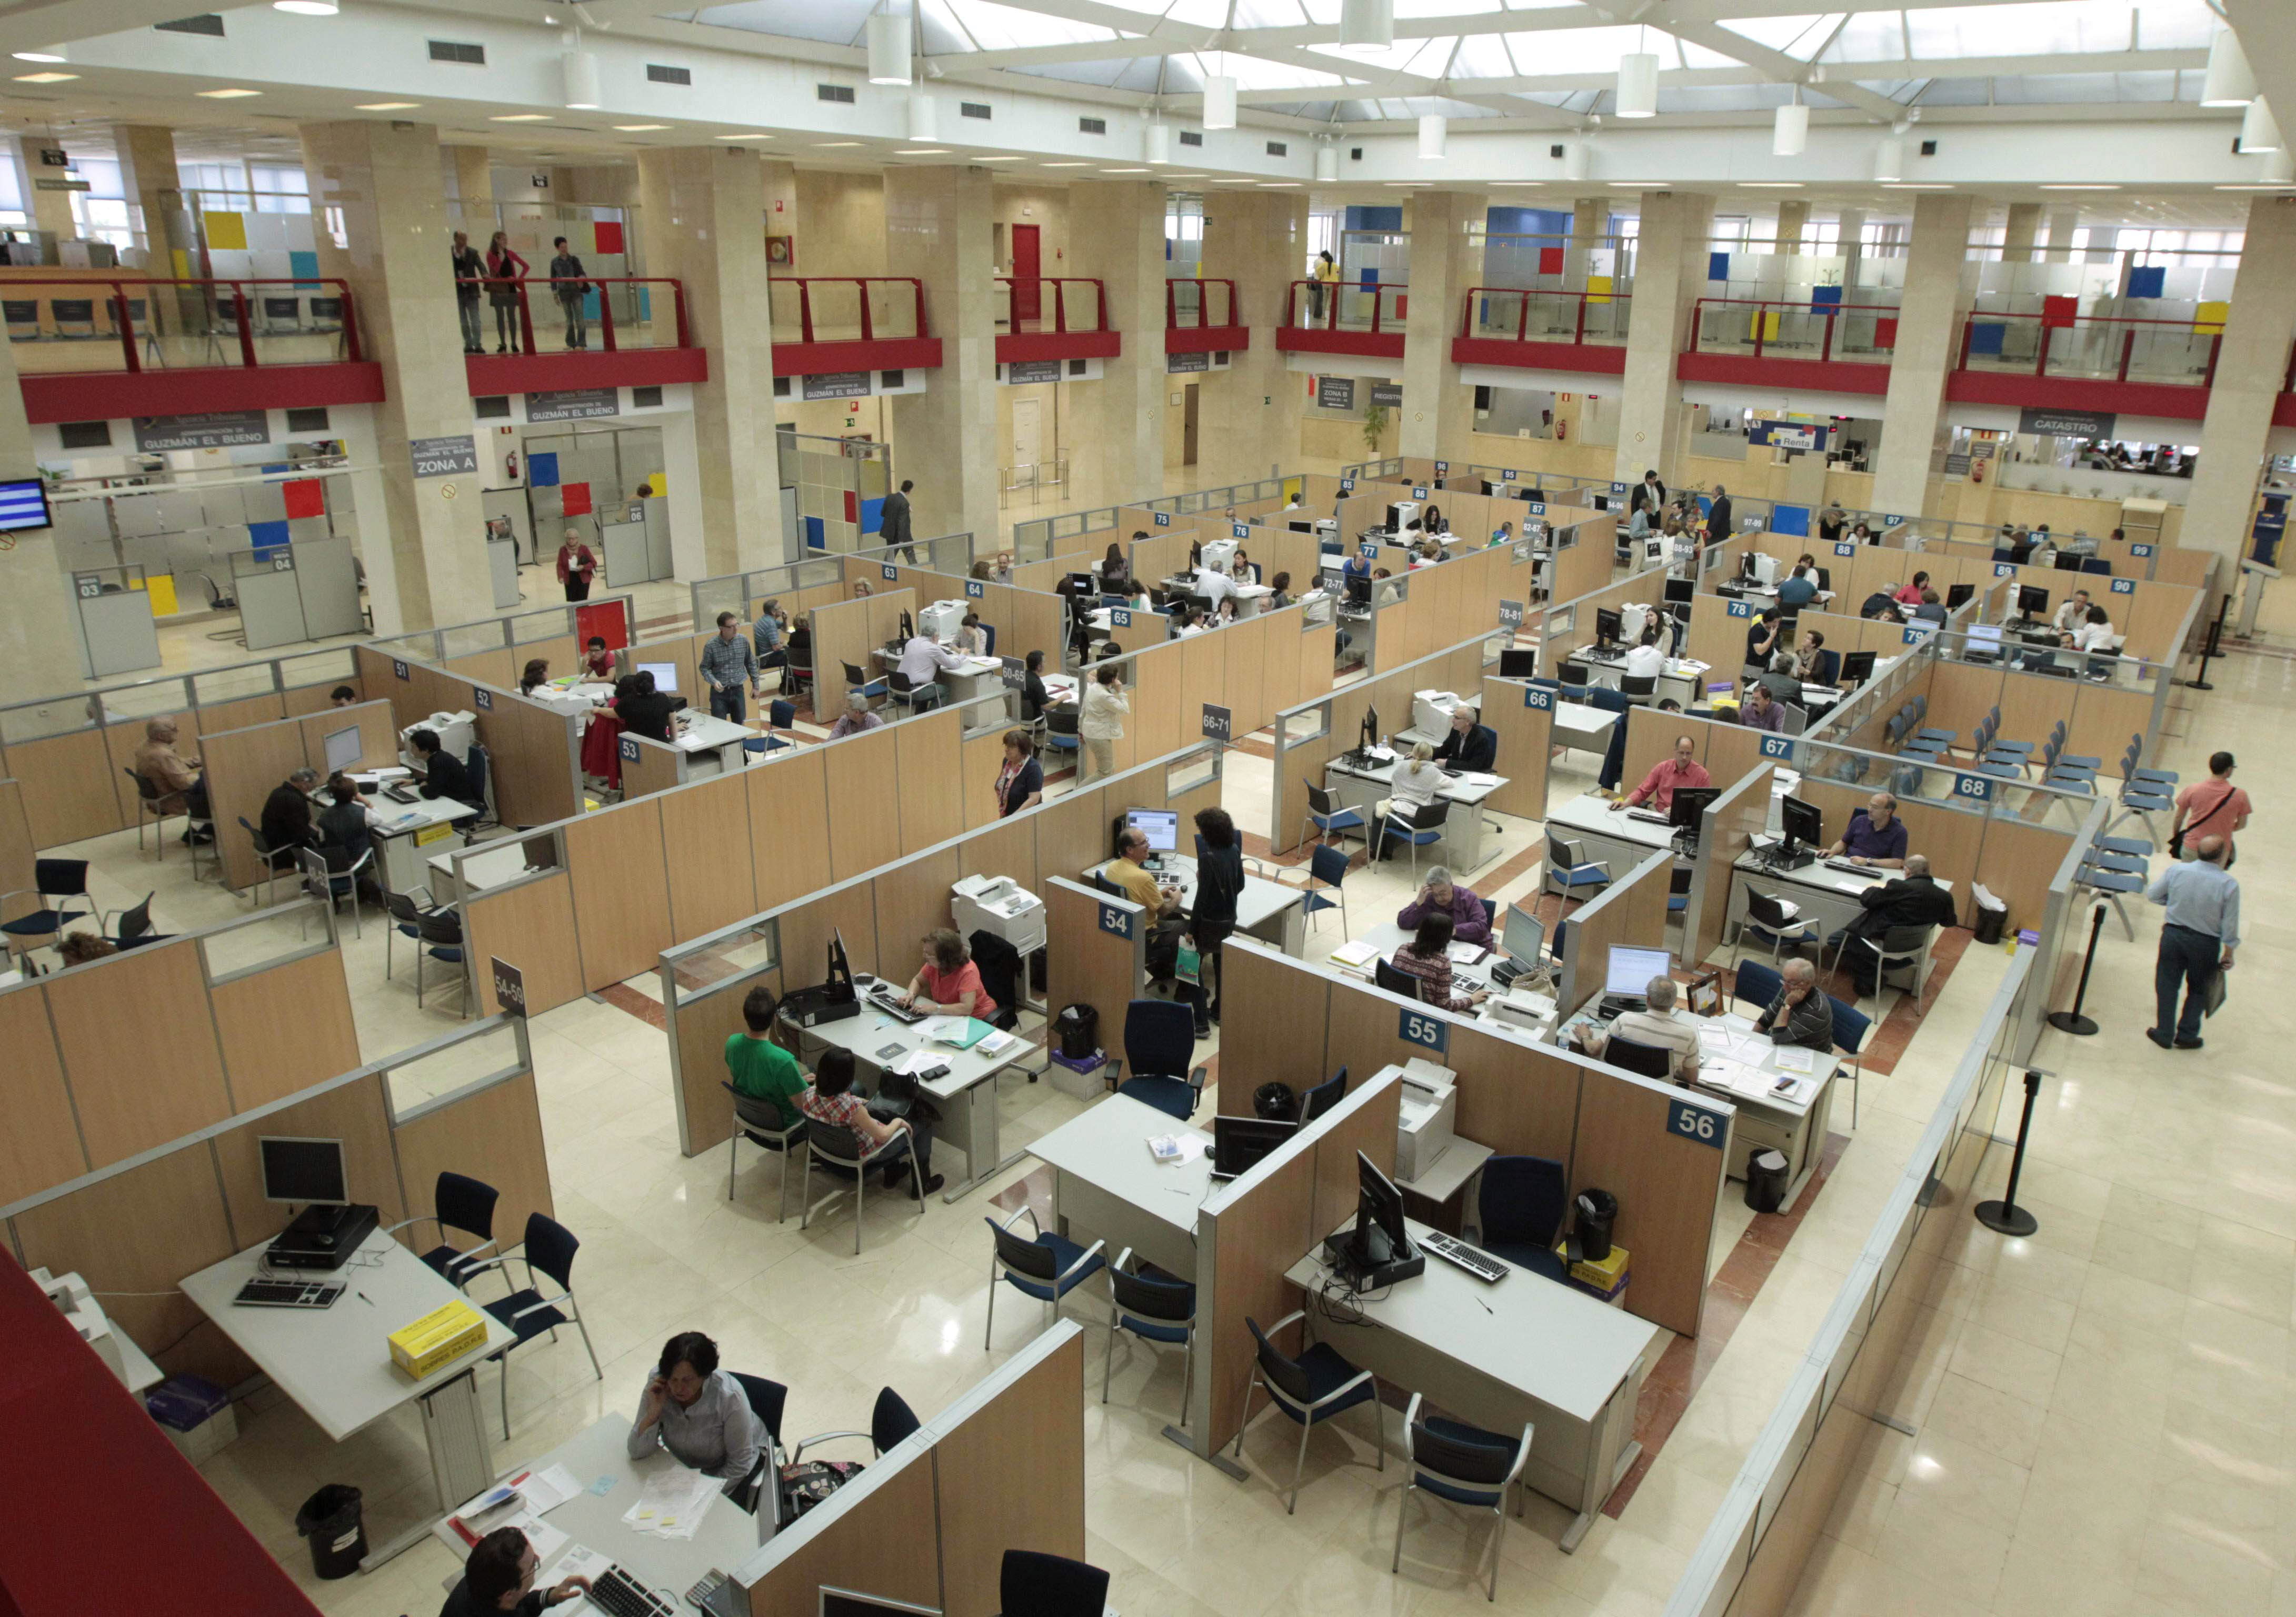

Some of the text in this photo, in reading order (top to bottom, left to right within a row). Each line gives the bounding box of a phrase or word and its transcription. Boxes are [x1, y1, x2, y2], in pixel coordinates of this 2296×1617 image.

[1012, 374, 1033, 383] GUZMÁN
[807, 390, 834, 398] GUZMÁN
[532, 409, 568, 420] GUZMÁN
[586, 406, 615, 416] BUENO
[2034, 420, 2098, 433] CATASTRO
[144, 432, 263, 450] GUZMÁN EL BUENO
[1784, 437, 1810, 447] Renta
[417, 456, 474, 473] ZONA A
[1505, 470, 1514, 478] 95
[1343, 480, 1352, 489] 85
[1614, 483, 1623, 492] 94
[1415, 489, 1425, 498] 86
[1532, 504, 1543, 514] 87
[1607, 501, 1624, 510] 94-96
[631, 512, 642, 521] 06
[1157, 514, 1167, 525] 75
[1887, 516, 1900, 525] 97
[1523, 523, 1541, 533] 82-87
[1744, 518, 1762, 528] 97-99
[1236, 526, 1247, 536] 76
[2031, 533, 2044, 543] 98
[1363, 546, 1375, 557] 77
[1674, 543, 1693, 554] 88-93
[1838, 545, 1851, 555] 88
[2134, 545, 2148, 556] 99
[275, 560, 291, 570] 04
[1998, 565, 2012, 576] 89
[884, 567, 895, 578] 63
[969, 584, 980, 595] 64
[1324, 578, 1343, 590] 72-77
[2114, 581, 2130, 592] 90
[81, 584, 99, 597] 03
[1500, 608, 1521, 621] 78-81
[1732, 603, 1746, 615] 78
[1114, 612, 1128, 624] 65
[1908, 630, 1923, 642] 79
[396, 661, 406, 677] 51
[1002, 667, 1025, 683] 60-65
[479, 690, 489, 706] 52
[1530, 692, 1548, 707] 66
[1203, 714, 1230, 732] 66-71
[623, 741, 637, 758] 53
[1766, 739, 1788, 755] 67
[1962, 778, 1985, 796] 68
[1105, 909, 1127, 933] 54
[495, 975, 524, 1005] 54-59
[1408, 1016, 1437, 1044] 55
[1679, 1107, 1715, 1139] 56
